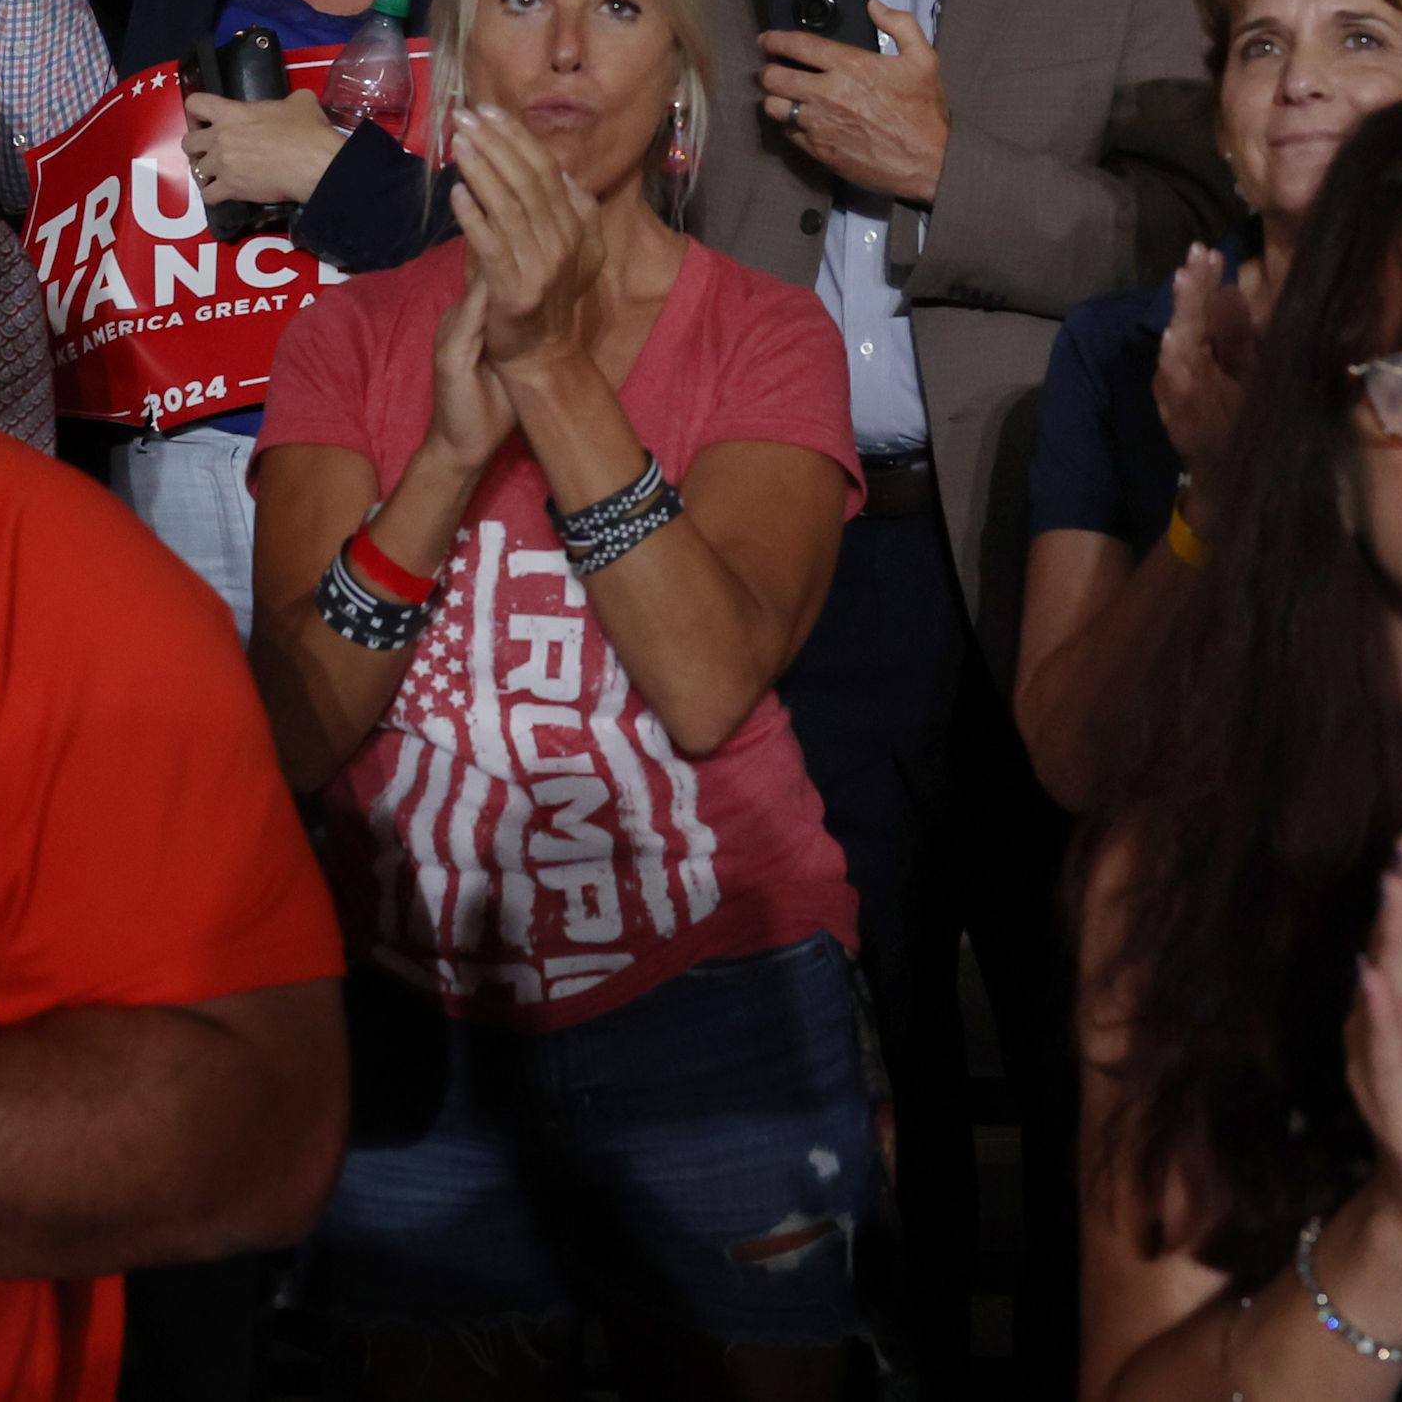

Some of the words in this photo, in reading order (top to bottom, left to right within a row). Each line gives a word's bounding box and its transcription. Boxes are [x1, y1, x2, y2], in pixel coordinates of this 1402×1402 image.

[33, 158, 209, 284] TRU
[82, 312, 185, 356] AMERICA
[195, 294, 289, 322] GREAT
[141, 375, 228, 419] 2024
[505, 548, 626, 946] TRUMP
